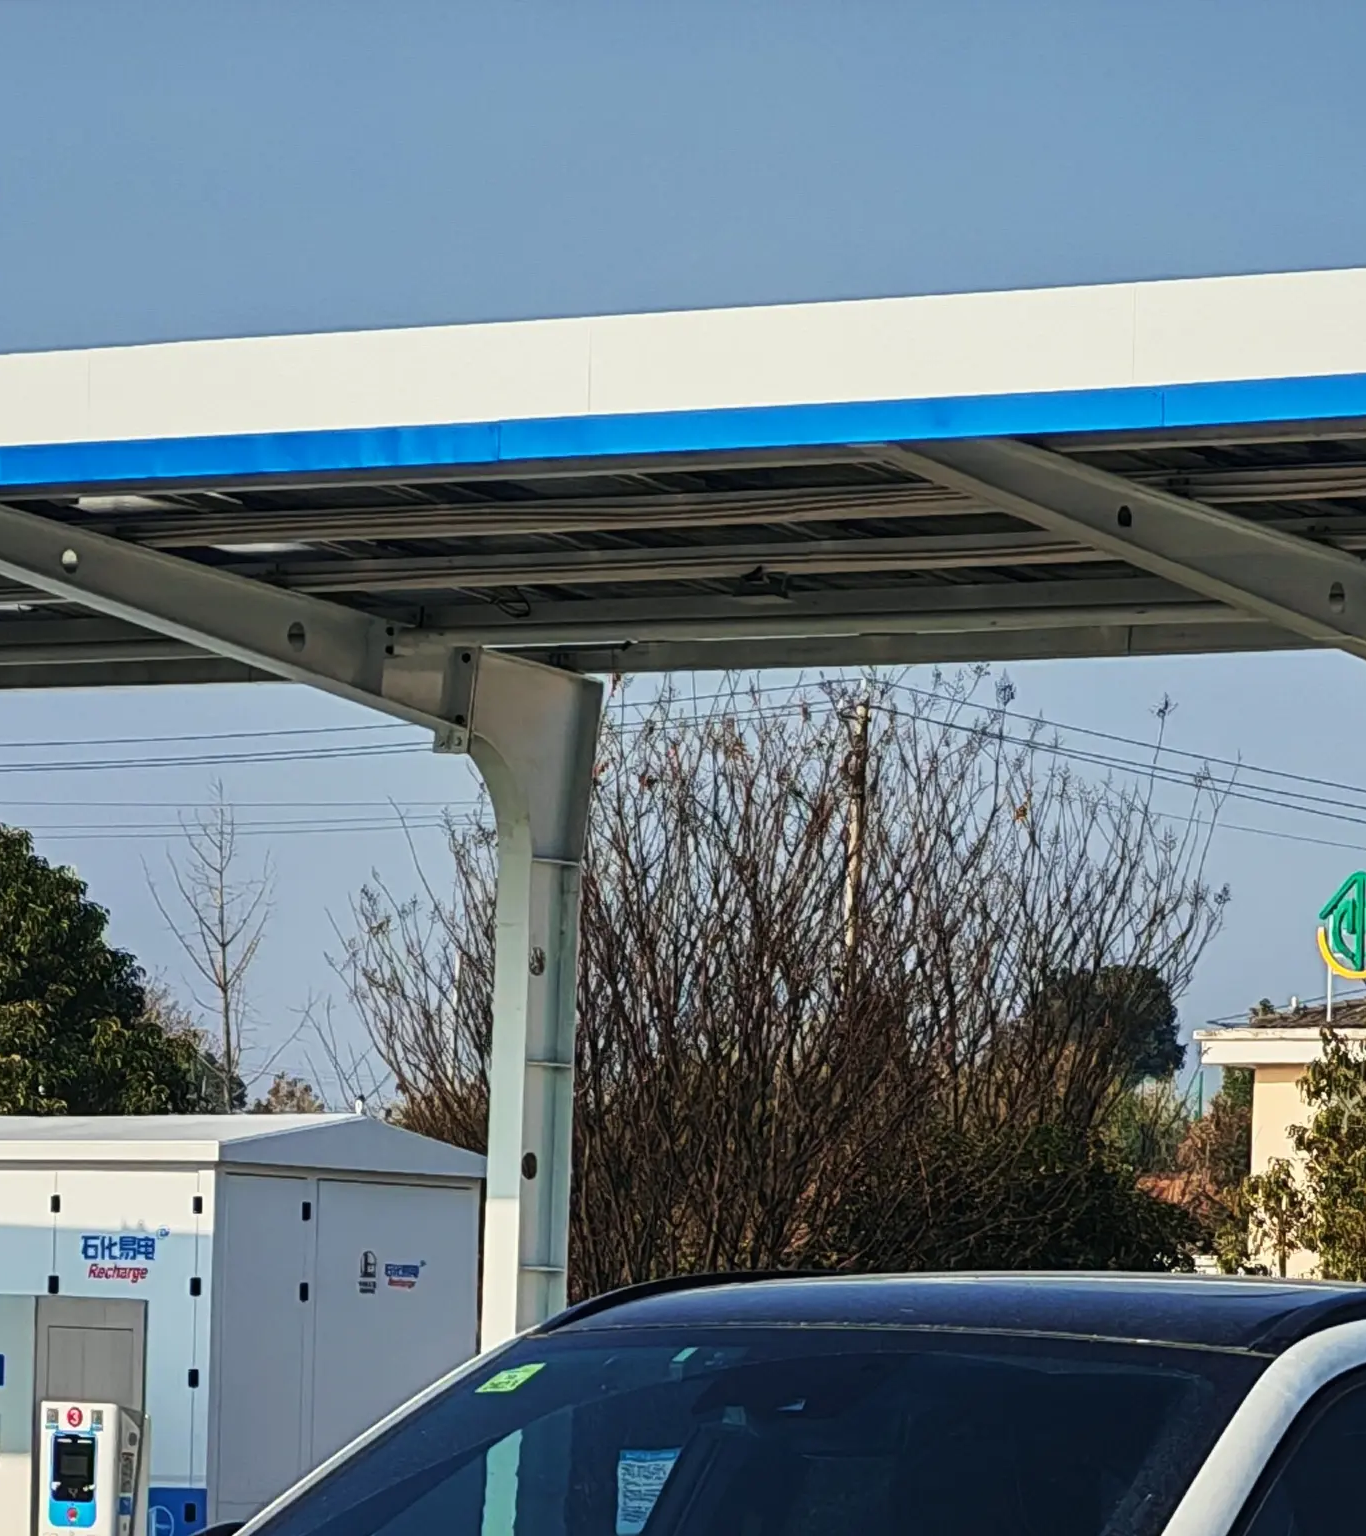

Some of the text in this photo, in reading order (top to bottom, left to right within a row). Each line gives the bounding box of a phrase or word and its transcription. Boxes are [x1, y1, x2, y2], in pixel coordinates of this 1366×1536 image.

[81, 1236, 155, 1260] 石化易电
[88, 1263, 149, 1283] Recharge
[70, 1409, 80, 1425] 3
